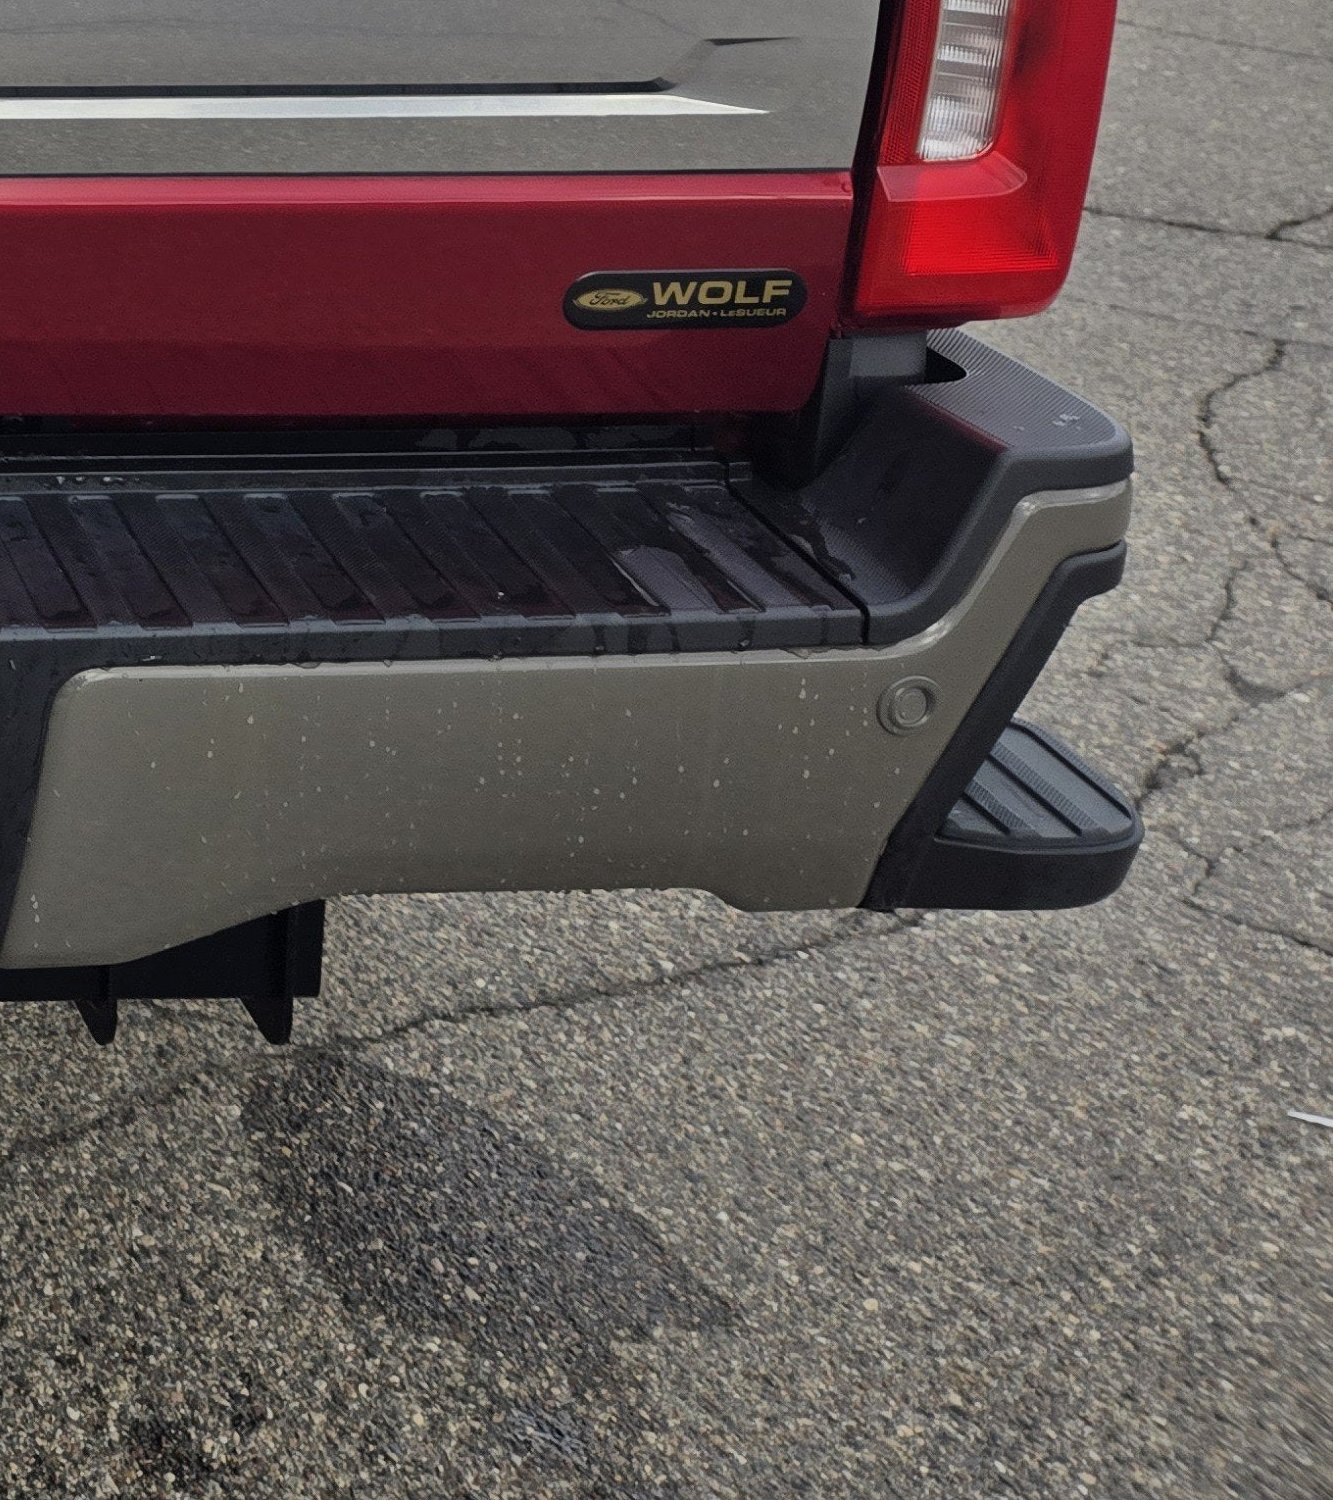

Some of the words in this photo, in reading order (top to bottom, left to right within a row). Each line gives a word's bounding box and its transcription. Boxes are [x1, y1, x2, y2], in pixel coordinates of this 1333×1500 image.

[588, 292, 631, 307] Ford
[652, 280, 793, 306] WOLF
[646, 309, 711, 319] JORDAN
